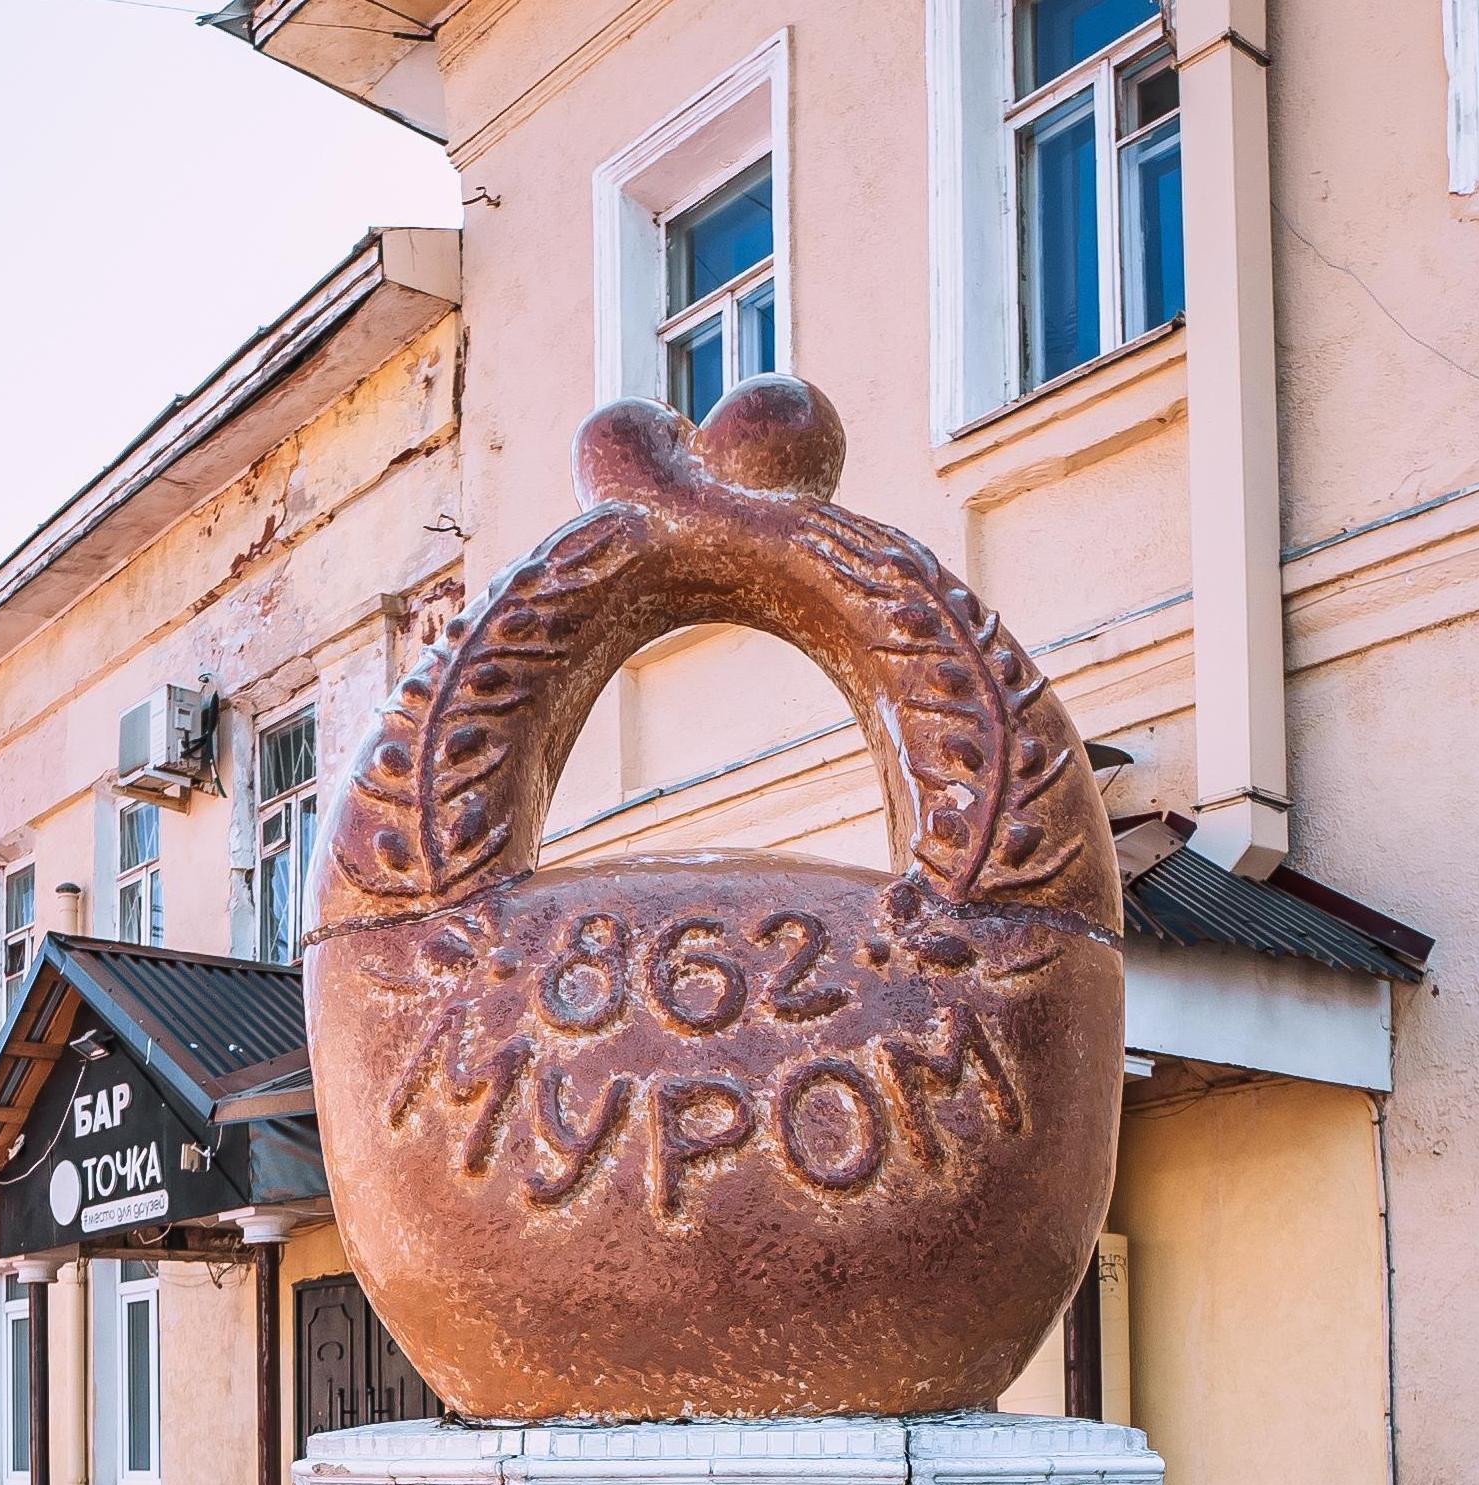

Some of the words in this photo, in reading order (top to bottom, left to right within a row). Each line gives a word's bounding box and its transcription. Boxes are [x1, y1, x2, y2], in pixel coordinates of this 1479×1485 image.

[535, 909, 857, 1037] 862
[74, 1083, 132, 1138] БАР
[386, 1002, 1028, 1219] МУРОМ
[82, 1141, 162, 1200] ТОЧКА
